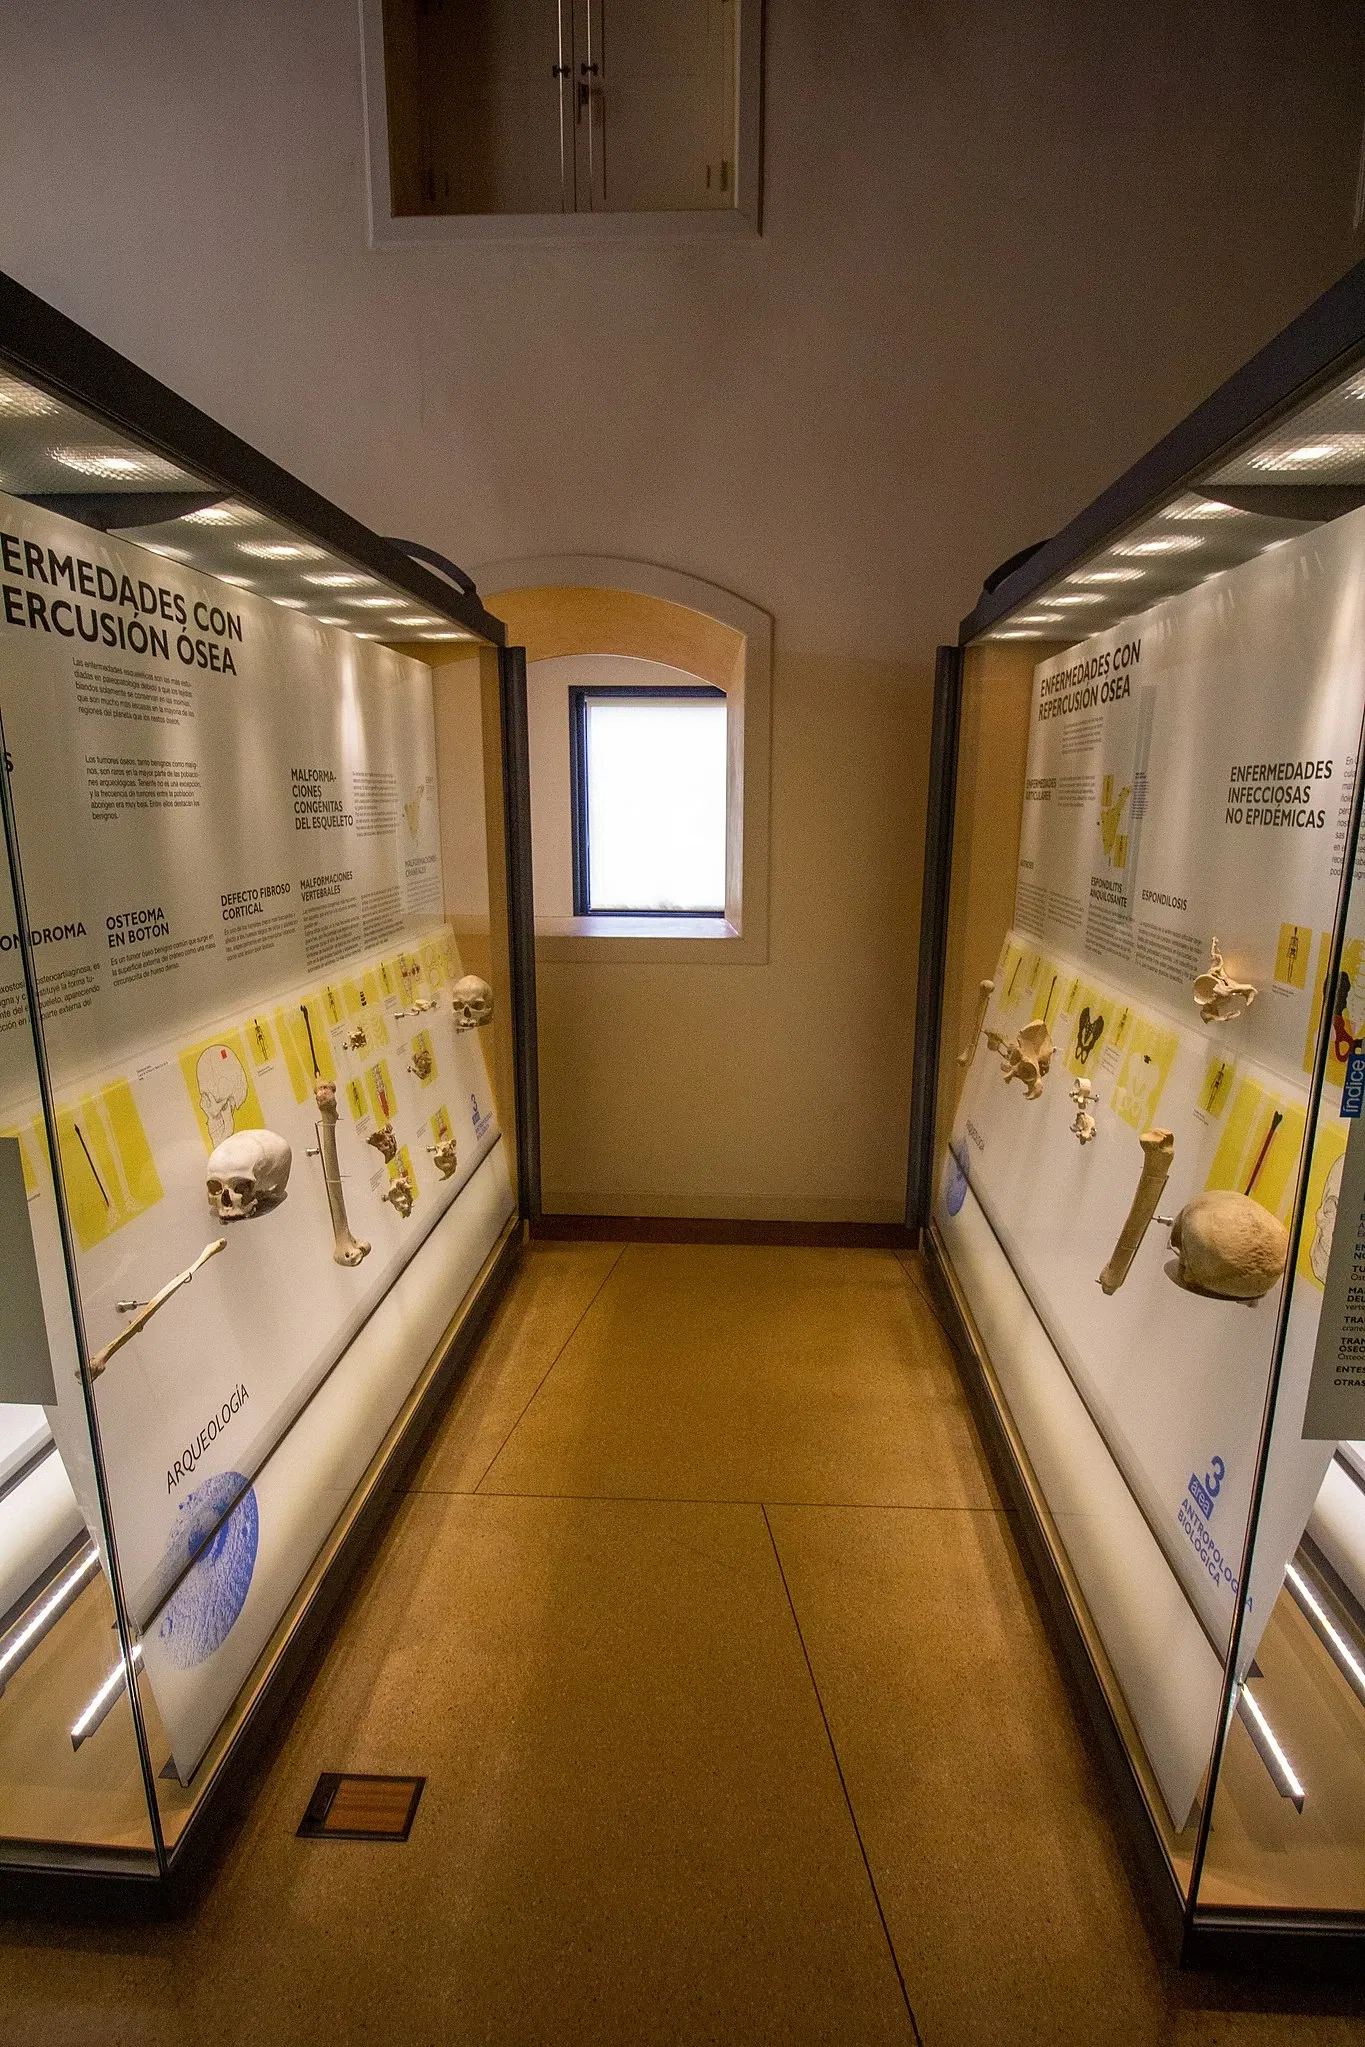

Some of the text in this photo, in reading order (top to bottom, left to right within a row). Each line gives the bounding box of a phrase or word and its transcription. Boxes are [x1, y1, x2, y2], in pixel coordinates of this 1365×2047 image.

[0, 531, 243, 642] ERMEDADES CON
[2, 584, 237, 676] ERCUSIÓN ÓSEA
[1040, 639, 1141, 698] ENFERMEDADES CON
[77, 694, 88, 704] que
[1038, 674, 1130, 721] REPERCUSIÓN ÓSEA
[85, 755, 96, 763] Los
[291, 768, 337, 782] MALFORMA-
[1230, 760, 1333, 782] ENFERMEDADES
[292, 784, 322, 798] CIONES
[1227, 785, 1311, 804] INFECCIOSAS
[295, 817, 311, 830] DEL
[312, 815, 354, 830] ESQUELETO
[1225, 807, 1243, 824] NO
[1245, 804, 1326, 829] EPIDÉMICAS
[300, 871, 353, 890] MALFORMACIONES
[221, 883, 290, 906] DEFECTO FIBROSO
[301, 884, 340, 902] VERTEBRALES
[1142, 890, 1187, 911] ESPONDILOSIS
[106, 907, 164, 930] OSTEOMA
[223, 902, 263, 920] CORTICAL
[108, 932, 125, 948] EN
[166, 1382, 249, 1495] ARQUEOLOGÍA
[1205, 1456, 1224, 1497] 3
[1182, 1498, 1253, 1613] ANTROPOLOGA
